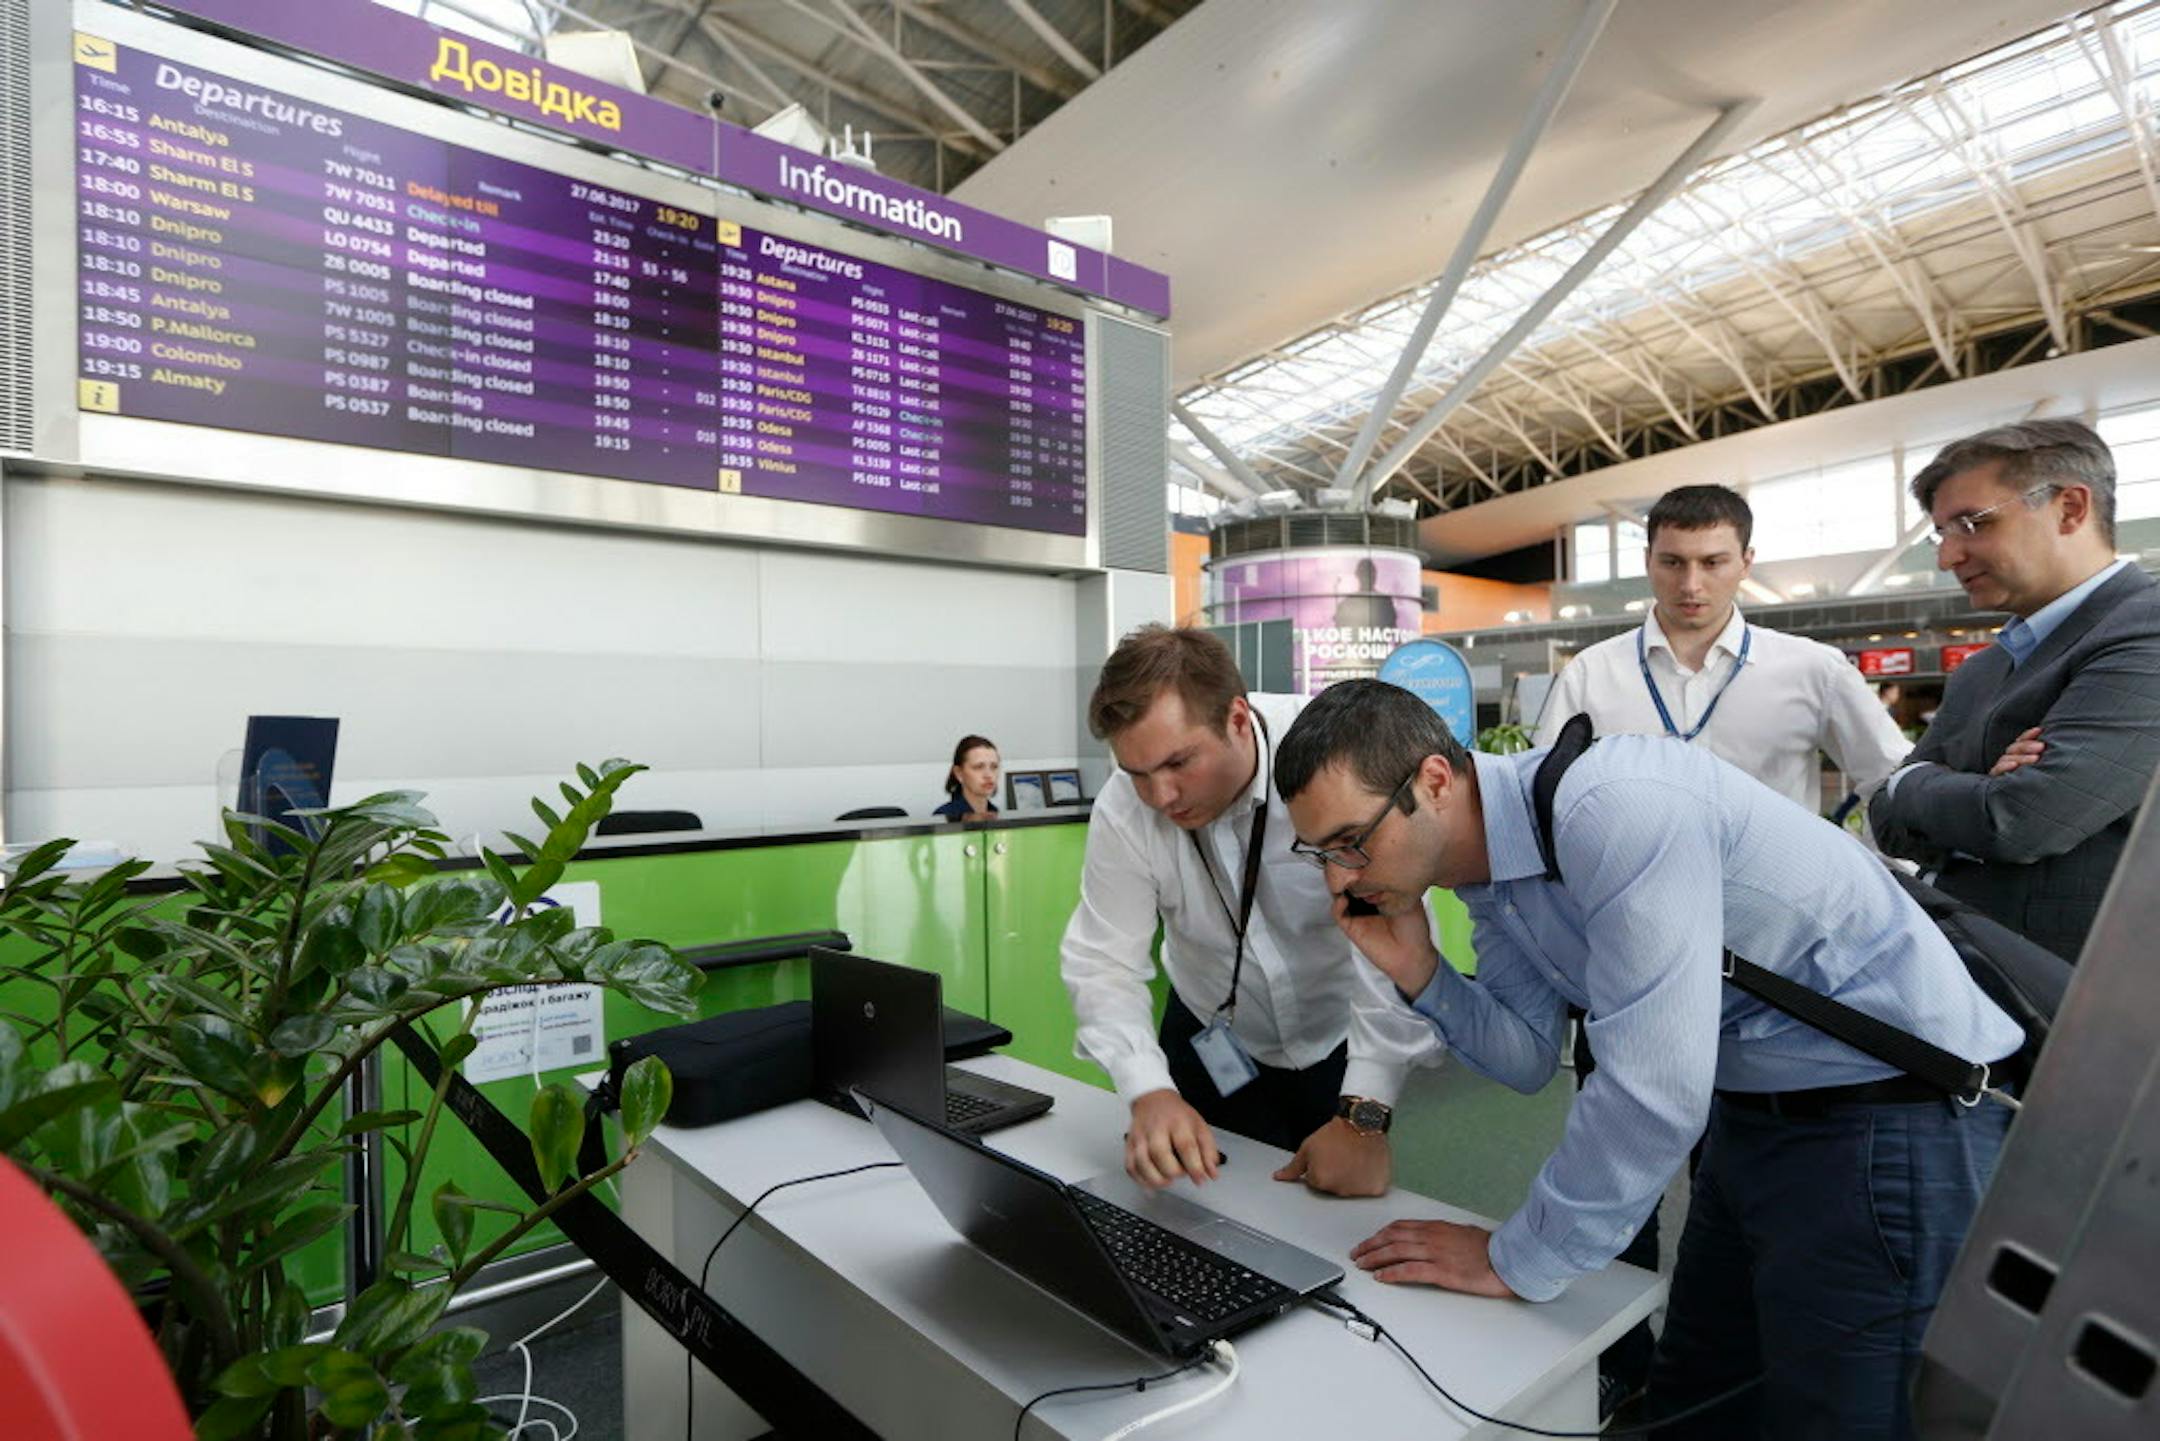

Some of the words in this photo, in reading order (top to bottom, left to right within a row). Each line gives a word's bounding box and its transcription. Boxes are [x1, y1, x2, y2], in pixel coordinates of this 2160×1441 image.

[429, 37, 622, 132] Довідка
[81, 94, 139, 122] 16:15
[155, 63, 342, 136] Departures
[81, 121, 139, 148] 16:55
[148, 113, 228, 146] Antalya
[82, 148, 140, 174] 17:40
[149, 138, 216, 167] Sharm
[220, 156, 238, 173] El
[241, 161, 253, 177] S
[149, 164, 216, 192] Sharm
[220, 181, 239, 198] El
[241, 186, 253, 201] S
[324, 159, 352, 178] 7W
[354, 167, 395, 190] 7011
[81, 174, 140, 199] 18:00
[324, 182, 352, 201] 7W
[405, 179, 472, 209] Delayed
[149, 189, 230, 220] Warsaw
[570, 183, 639, 212] 27.06.2017
[779, 154, 963, 244] Information
[82, 200, 140, 225] 18:10
[323, 206, 350, 224] QU
[657, 207, 698, 230] 19:20
[150, 214, 222, 243] Dnipro
[324, 230, 346, 247] LO
[83, 228, 140, 252] 18:10
[406, 225, 485, 256] Departed
[150, 241, 222, 269] Dnipro
[324, 253, 345, 270] Z6
[406, 248, 485, 277] Departed
[760, 235, 862, 279] Departures
[83, 254, 141, 277] 18:10
[721, 263, 752, 281] 19:25
[151, 266, 222, 293] Dnipro
[324, 277, 345, 294] PS
[756, 273, 796, 291] Astana
[84, 280, 140, 302] 18:45
[406, 271, 481, 302] Boarding
[483, 288, 533, 309] closed
[721, 282, 752, 299] 19:30
[756, 290, 796, 309] Dnipro
[150, 292, 230, 319] Antalya
[324, 300, 352, 317] 7W
[406, 294, 482, 324] Boarding
[483, 311, 533, 331] closed
[721, 301, 752, 318] 19:30
[898, 308, 921, 322] Last
[84, 305, 141, 328] 18:50
[756, 308, 796, 328] Dnipro
[151, 316, 255, 347] P.Mallorca
[324, 323, 345, 340] PS
[406, 316, 482, 346] Boarding
[484, 332, 533, 352] closed
[722, 320, 753, 336] 19:30
[756, 326, 796, 346] Dnipro
[898, 325, 921, 338] Last
[84, 332, 141, 353] 19:00
[721, 339, 753, 355] 19:30
[898, 342, 920, 355] Last
[150, 342, 242, 369] Colombo
[324, 347, 345, 363] PS
[482, 353, 532, 373] closed
[756, 346, 804, 365] Istanbul
[899, 358, 920, 372] Last
[84, 358, 141, 378] 19:15
[721, 359, 753, 375] 19:30
[756, 365, 804, 384] Istanbul
[151, 368, 225, 394] Almaty
[324, 370, 346, 386] PS
[406, 361, 482, 389] Boarding
[484, 375, 533, 394] closed
[721, 377, 753, 393] 19:30
[899, 375, 920, 389] Last
[324, 393, 346, 409] PS
[407, 383, 483, 410] Boarding
[756, 383, 811, 403] Paris/CDG
[899, 394, 920, 407] Last
[722, 396, 753, 412] 19:30
[757, 402, 811, 421] Paris/CDG
[407, 406, 482, 432] Boarding
[484, 418, 534, 437] closed
[722, 415, 752, 430] 19:35
[756, 421, 792, 436] Odesa
[722, 434, 753, 449] 19:35
[757, 439, 792, 454] Odesa
[899, 444, 920, 457] Last
[722, 453, 753, 467] 19:35
[757, 458, 796, 473] Vilnius
[899, 461, 920, 474] Last
[899, 478, 921, 491] Last
